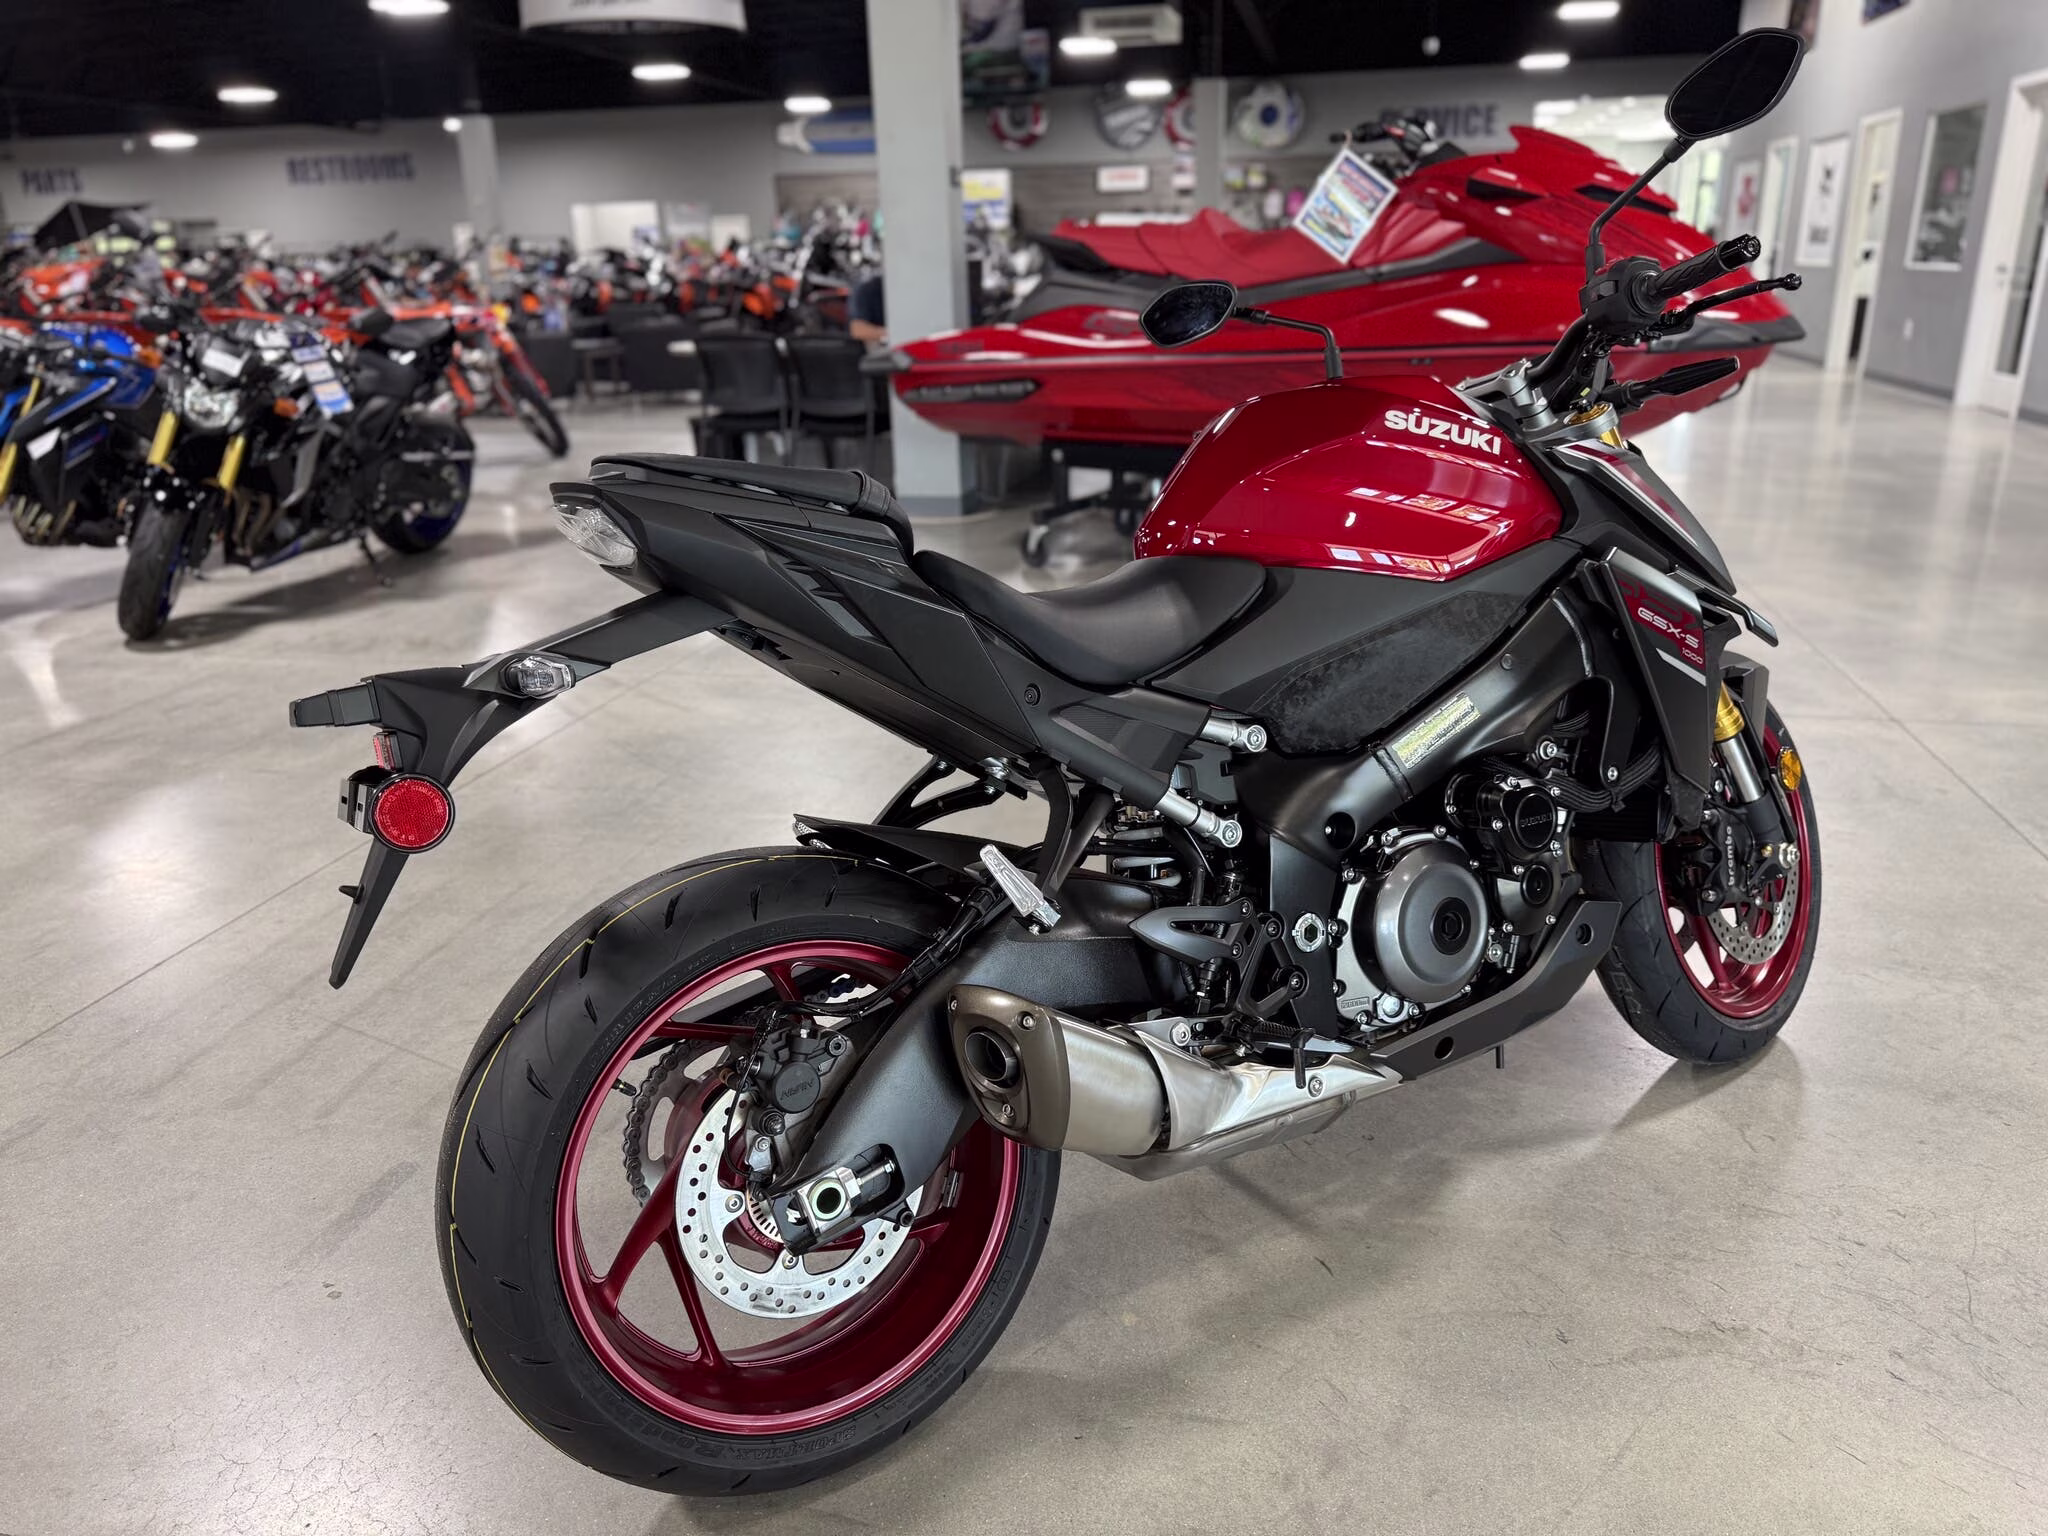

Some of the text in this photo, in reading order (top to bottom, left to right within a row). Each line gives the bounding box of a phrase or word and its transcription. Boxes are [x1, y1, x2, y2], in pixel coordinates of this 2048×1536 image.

[1384, 409, 1501, 455] SUZUKI
[1637, 607, 1699, 649] GSX-S
[1680, 647, 1703, 665] 1000
[1725, 825, 1736, 887] brembo
